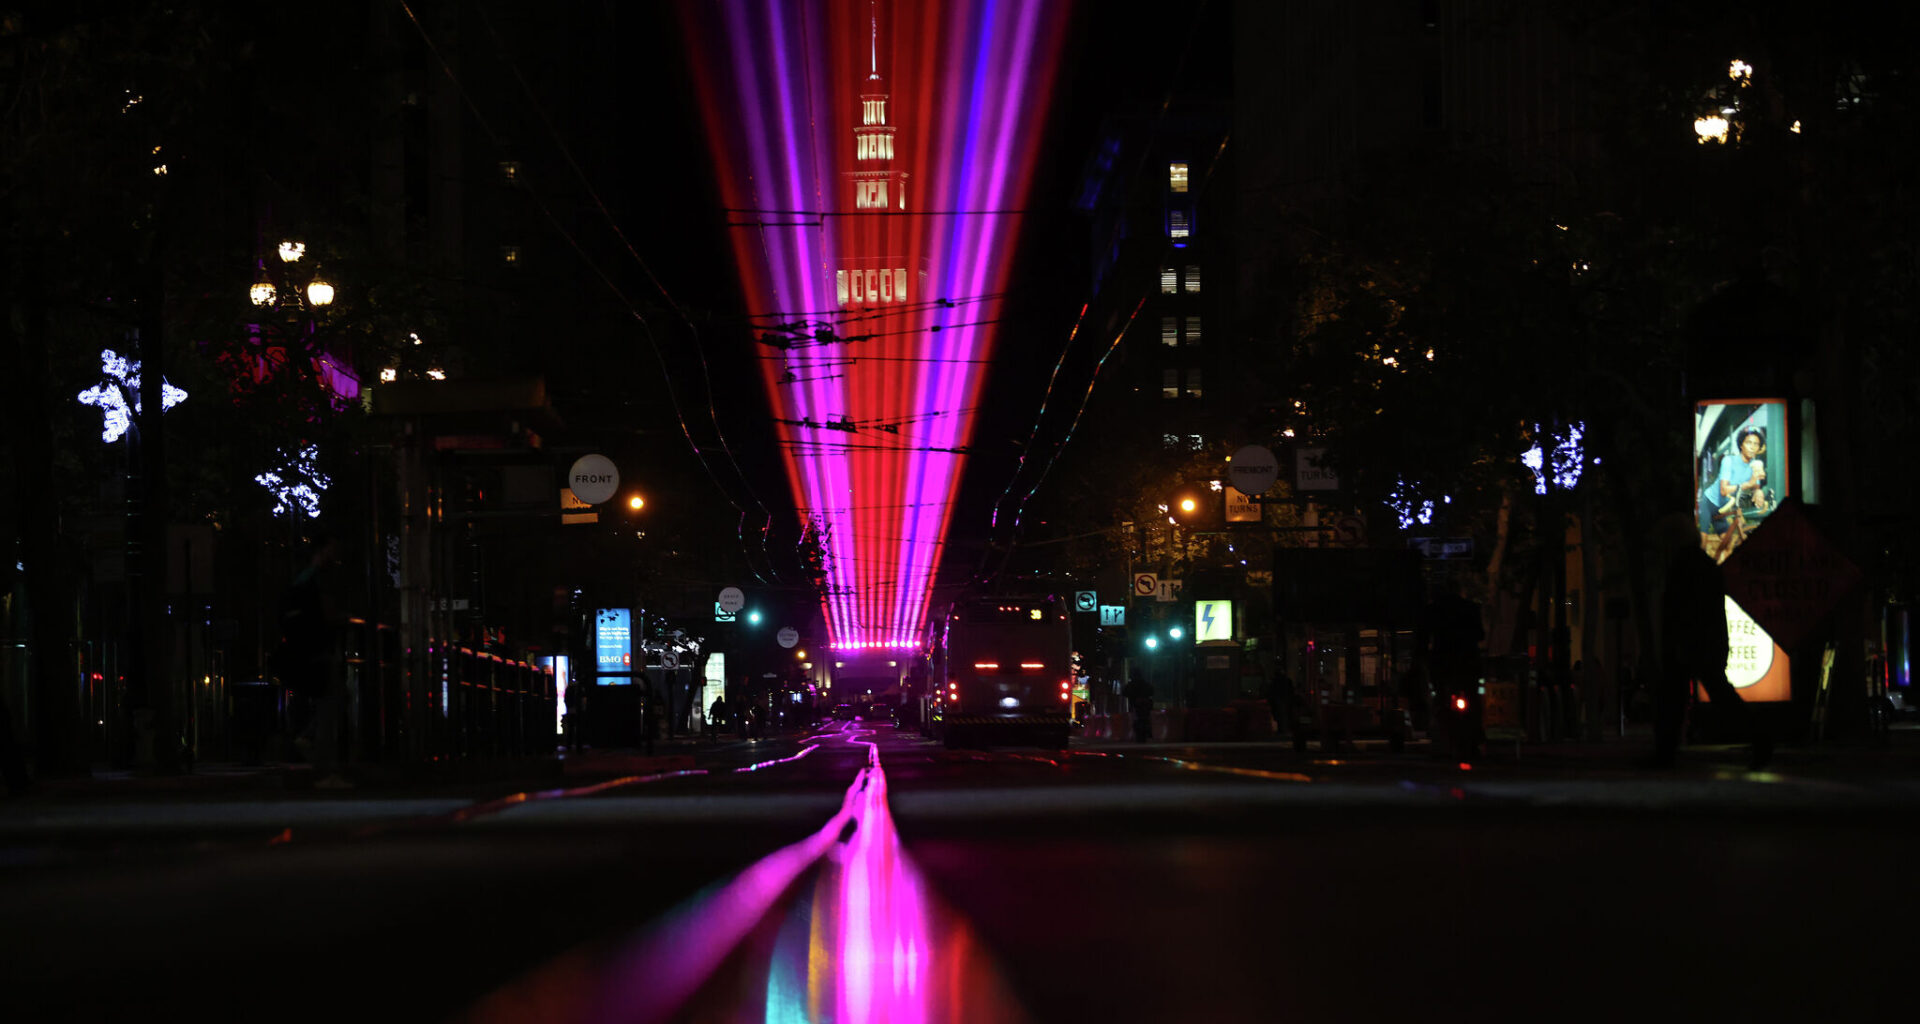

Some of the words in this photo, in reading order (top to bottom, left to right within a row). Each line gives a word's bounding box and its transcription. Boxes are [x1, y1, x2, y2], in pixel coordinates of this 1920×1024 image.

[1233, 465, 1273, 474] FREMONT
[575, 474, 613, 483] FRONT
[1300, 471, 1337, 480] TURNS
[1229, 504, 1258, 513] TURNS
[1729, 620, 1756, 635] FFEE
[1730, 645, 1757, 659] FFEE
[599, 655, 621, 663] BMO
